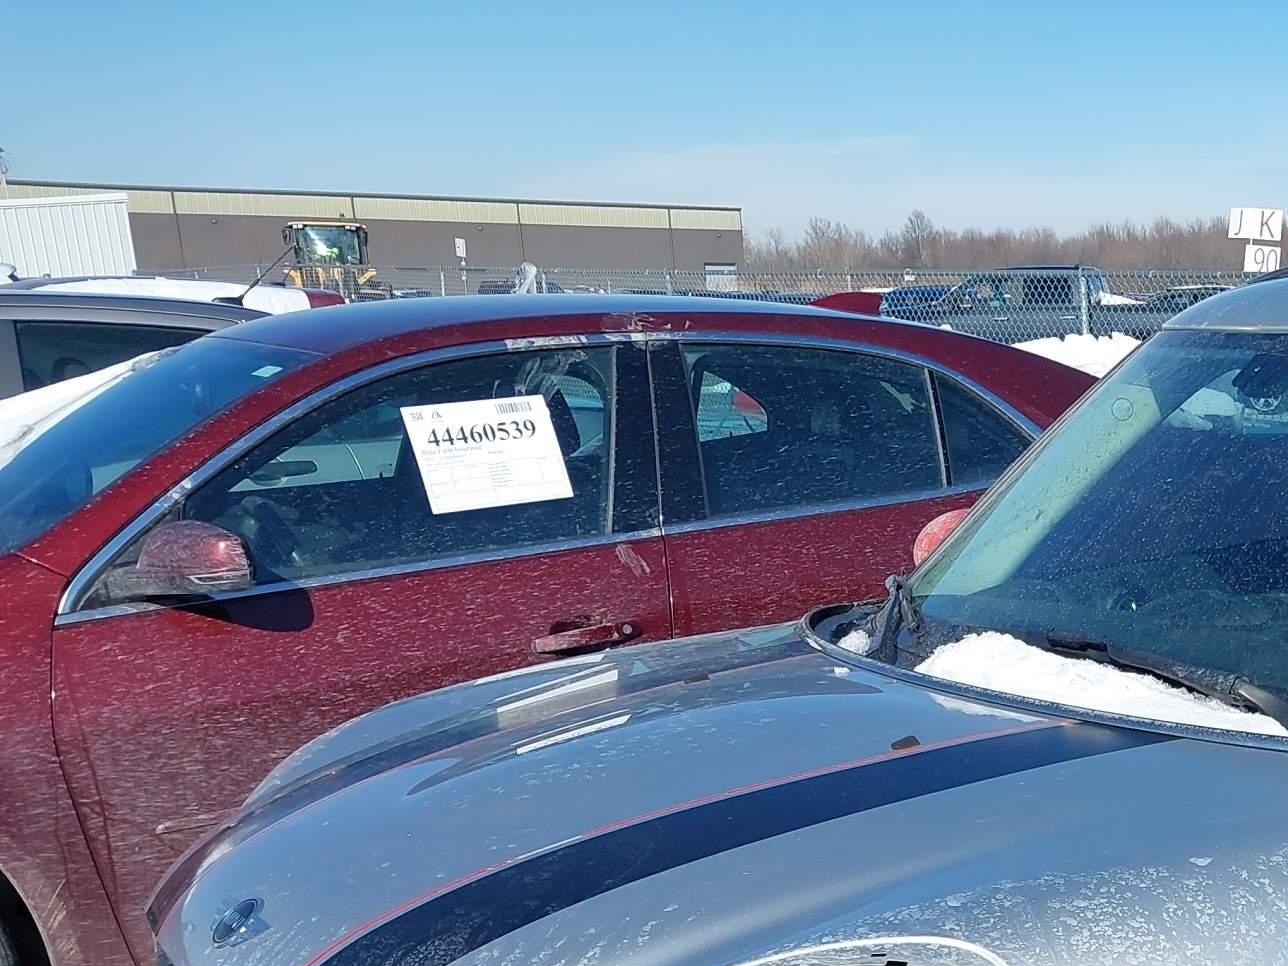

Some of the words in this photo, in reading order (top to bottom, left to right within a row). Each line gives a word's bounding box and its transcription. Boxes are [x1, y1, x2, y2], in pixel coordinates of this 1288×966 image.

[1233, 209, 1244, 236] J
[1259, 210, 1276, 239] K
[1254, 247, 1278, 273] 90
[427, 419, 537, 447] 44460539
